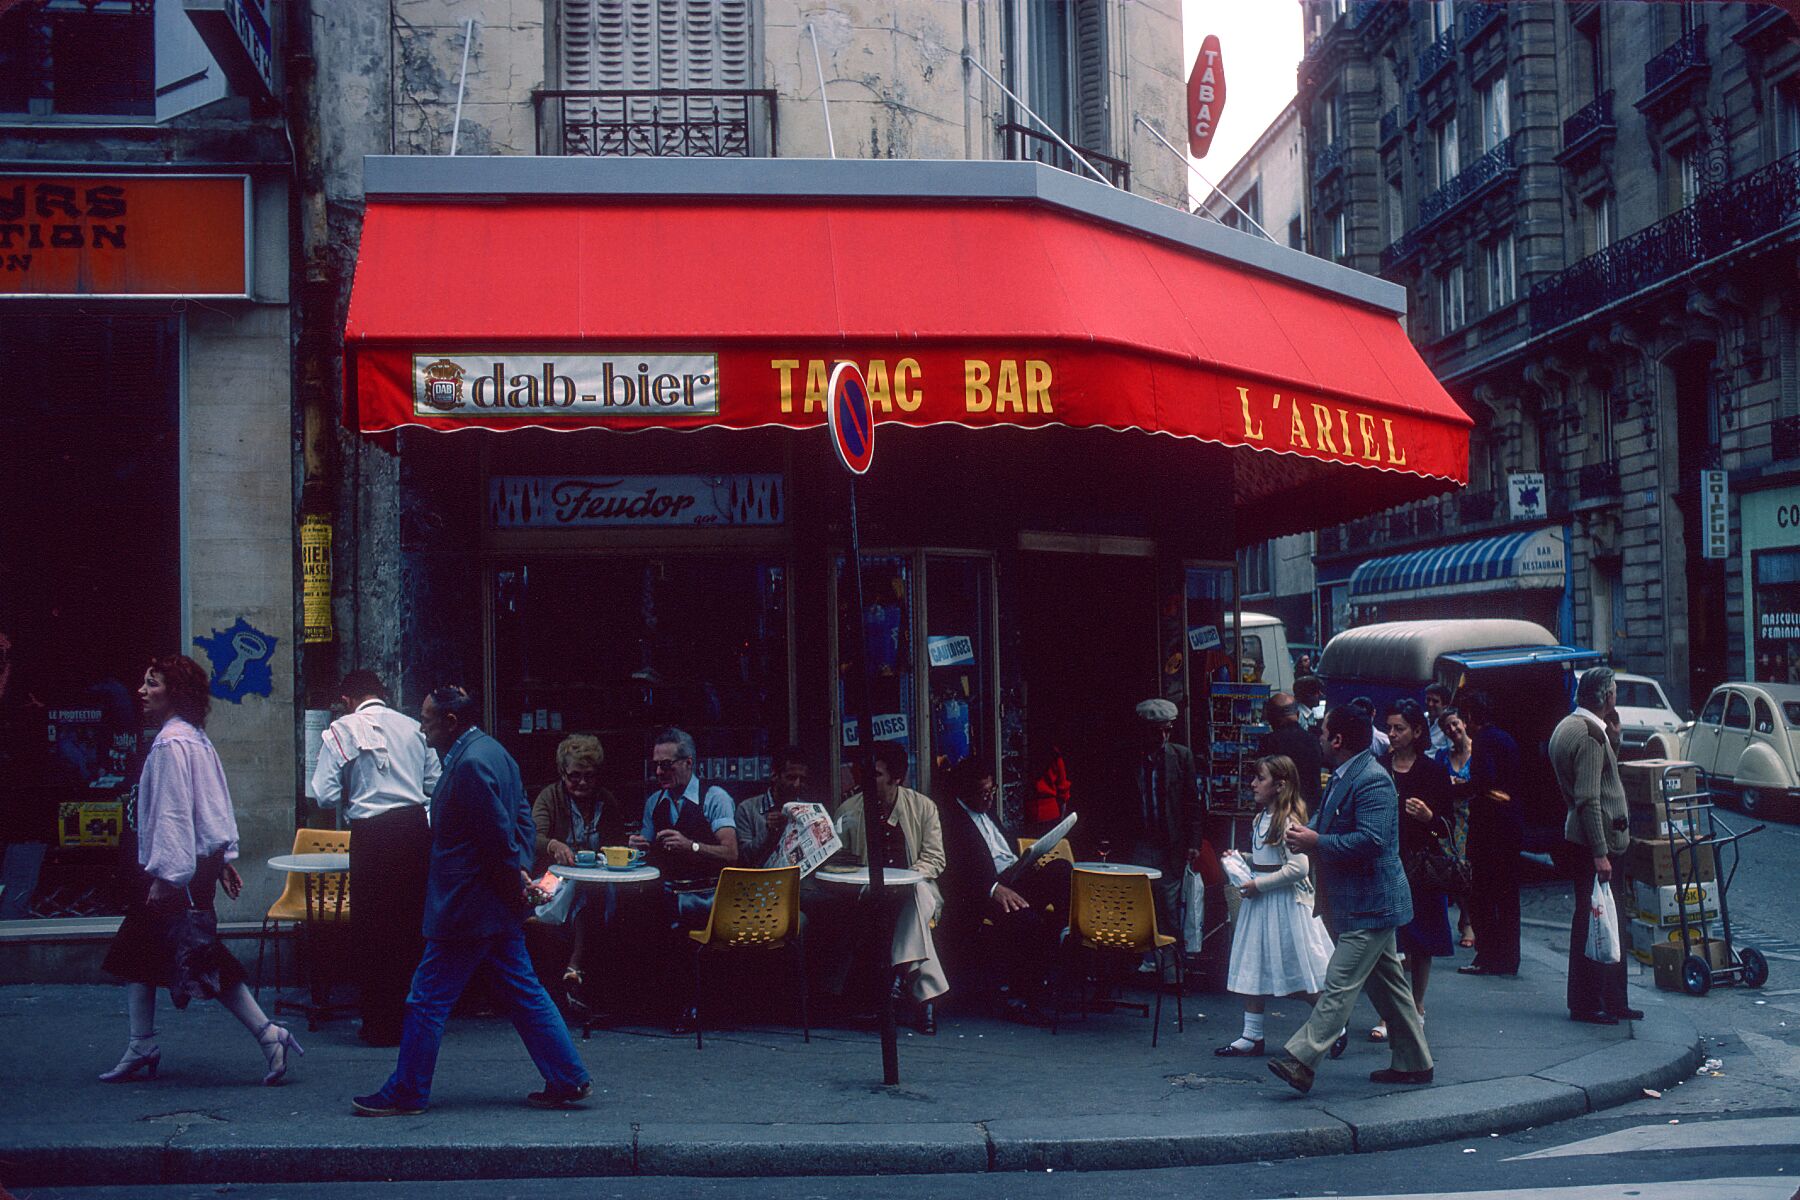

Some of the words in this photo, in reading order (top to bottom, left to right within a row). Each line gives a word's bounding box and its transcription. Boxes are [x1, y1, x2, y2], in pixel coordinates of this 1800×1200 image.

[1196, 51, 1218, 137] TABAC
[435, 384, 453, 395] DAB
[471, 361, 711, 408] dab-bier
[771, 357, 923, 413] TAAC
[964, 358, 1054, 413] BAR
[1236, 386, 1407, 466] L'ARIEL
[552, 478, 695, 523] Feudor
[1709, 472, 1726, 556] COIFFURE
[1522, 559, 1564, 571] RESTAURANT
[1761, 612, 1800, 625] MASCULI
[930, 638, 971, 664] GAULOISES
[846, 717, 905, 742] GAOISES
